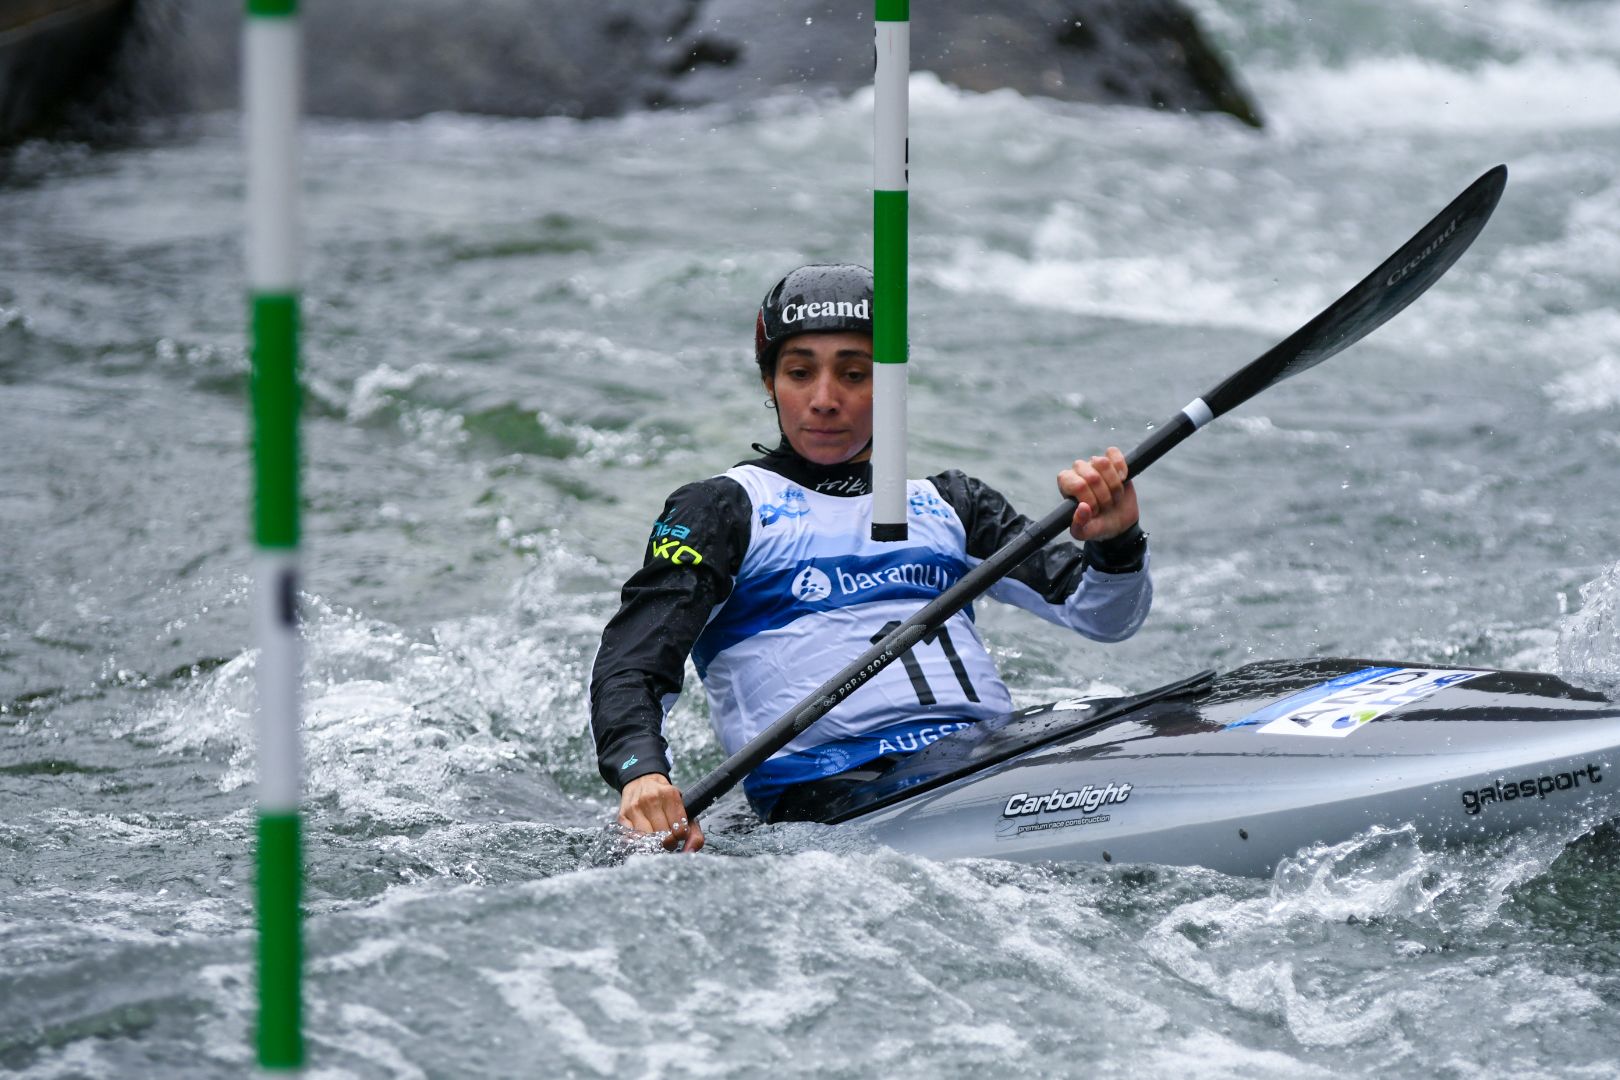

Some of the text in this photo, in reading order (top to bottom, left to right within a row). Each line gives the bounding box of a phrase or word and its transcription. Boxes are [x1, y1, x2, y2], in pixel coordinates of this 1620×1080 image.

[782, 299, 870, 324] Creand
[867, 650, 894, 673] 2024
[870, 620, 981, 706] 11
[1288, 671, 1429, 728] AND
[1003, 783, 1132, 818] Carbolight
[1462, 763, 1603, 815] galasport
[1018, 814, 1110, 833] premium race construction
